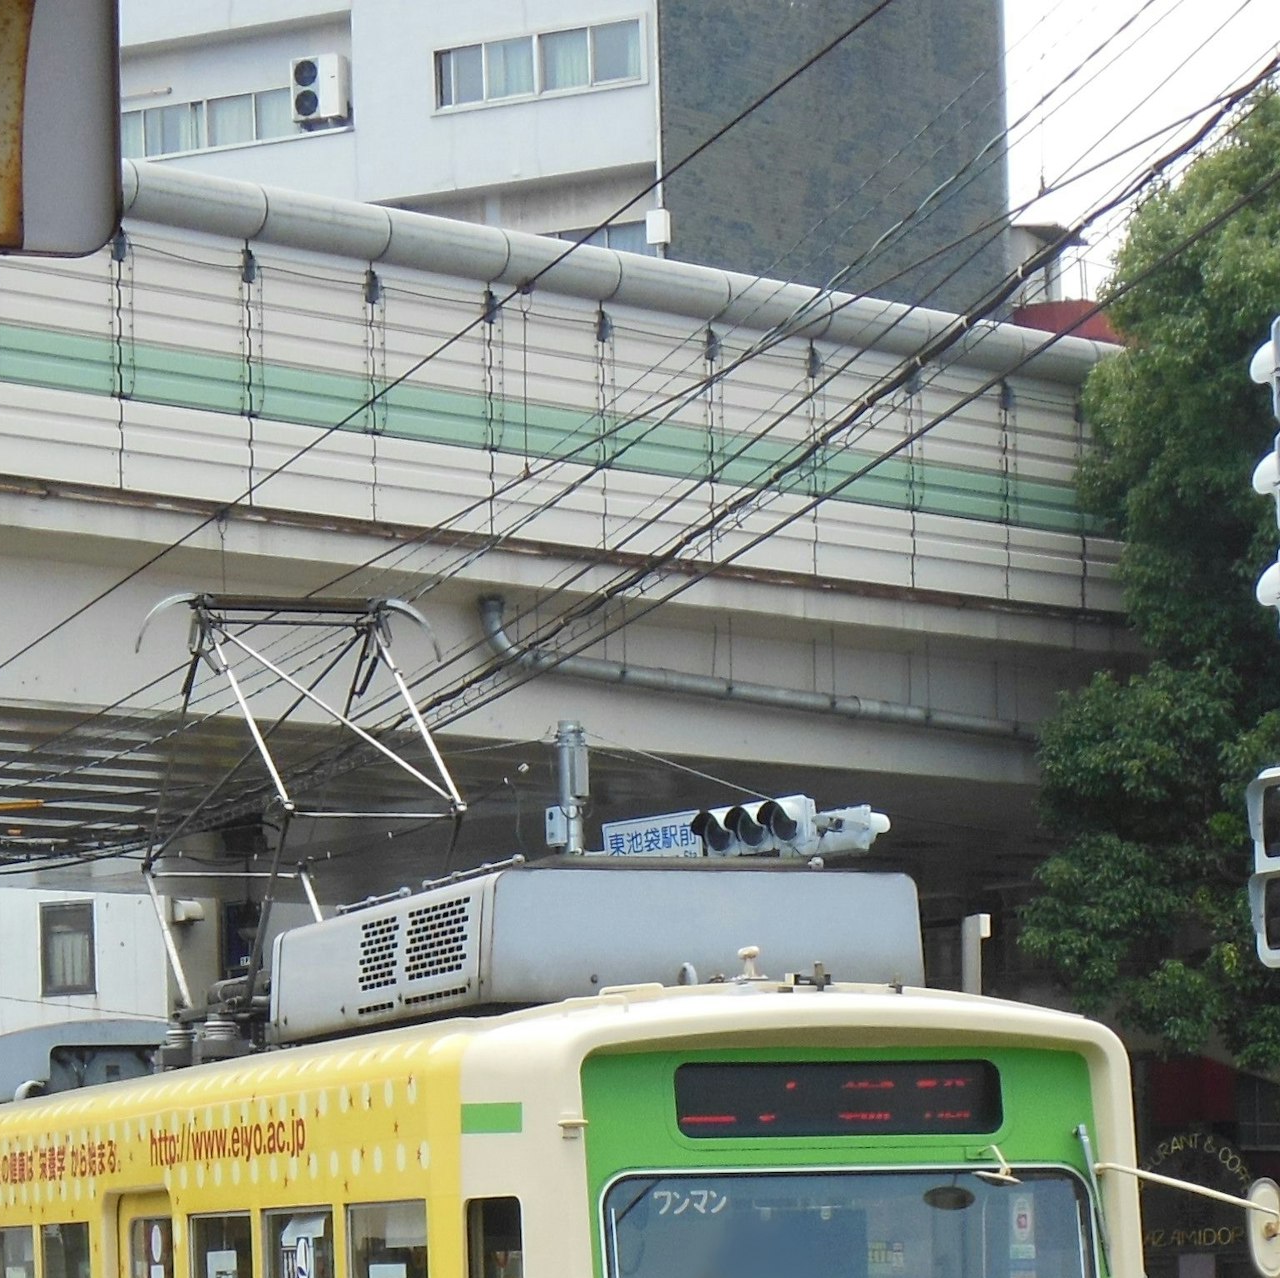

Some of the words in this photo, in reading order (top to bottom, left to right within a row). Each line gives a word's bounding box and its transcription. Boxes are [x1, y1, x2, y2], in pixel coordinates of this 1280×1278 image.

[608, 822, 697, 857] 東池袋駅前
[149, 1110, 306, 1169] http://www.eiyo.ac.jp
[653, 1188, 728, 1216] ワンマン
